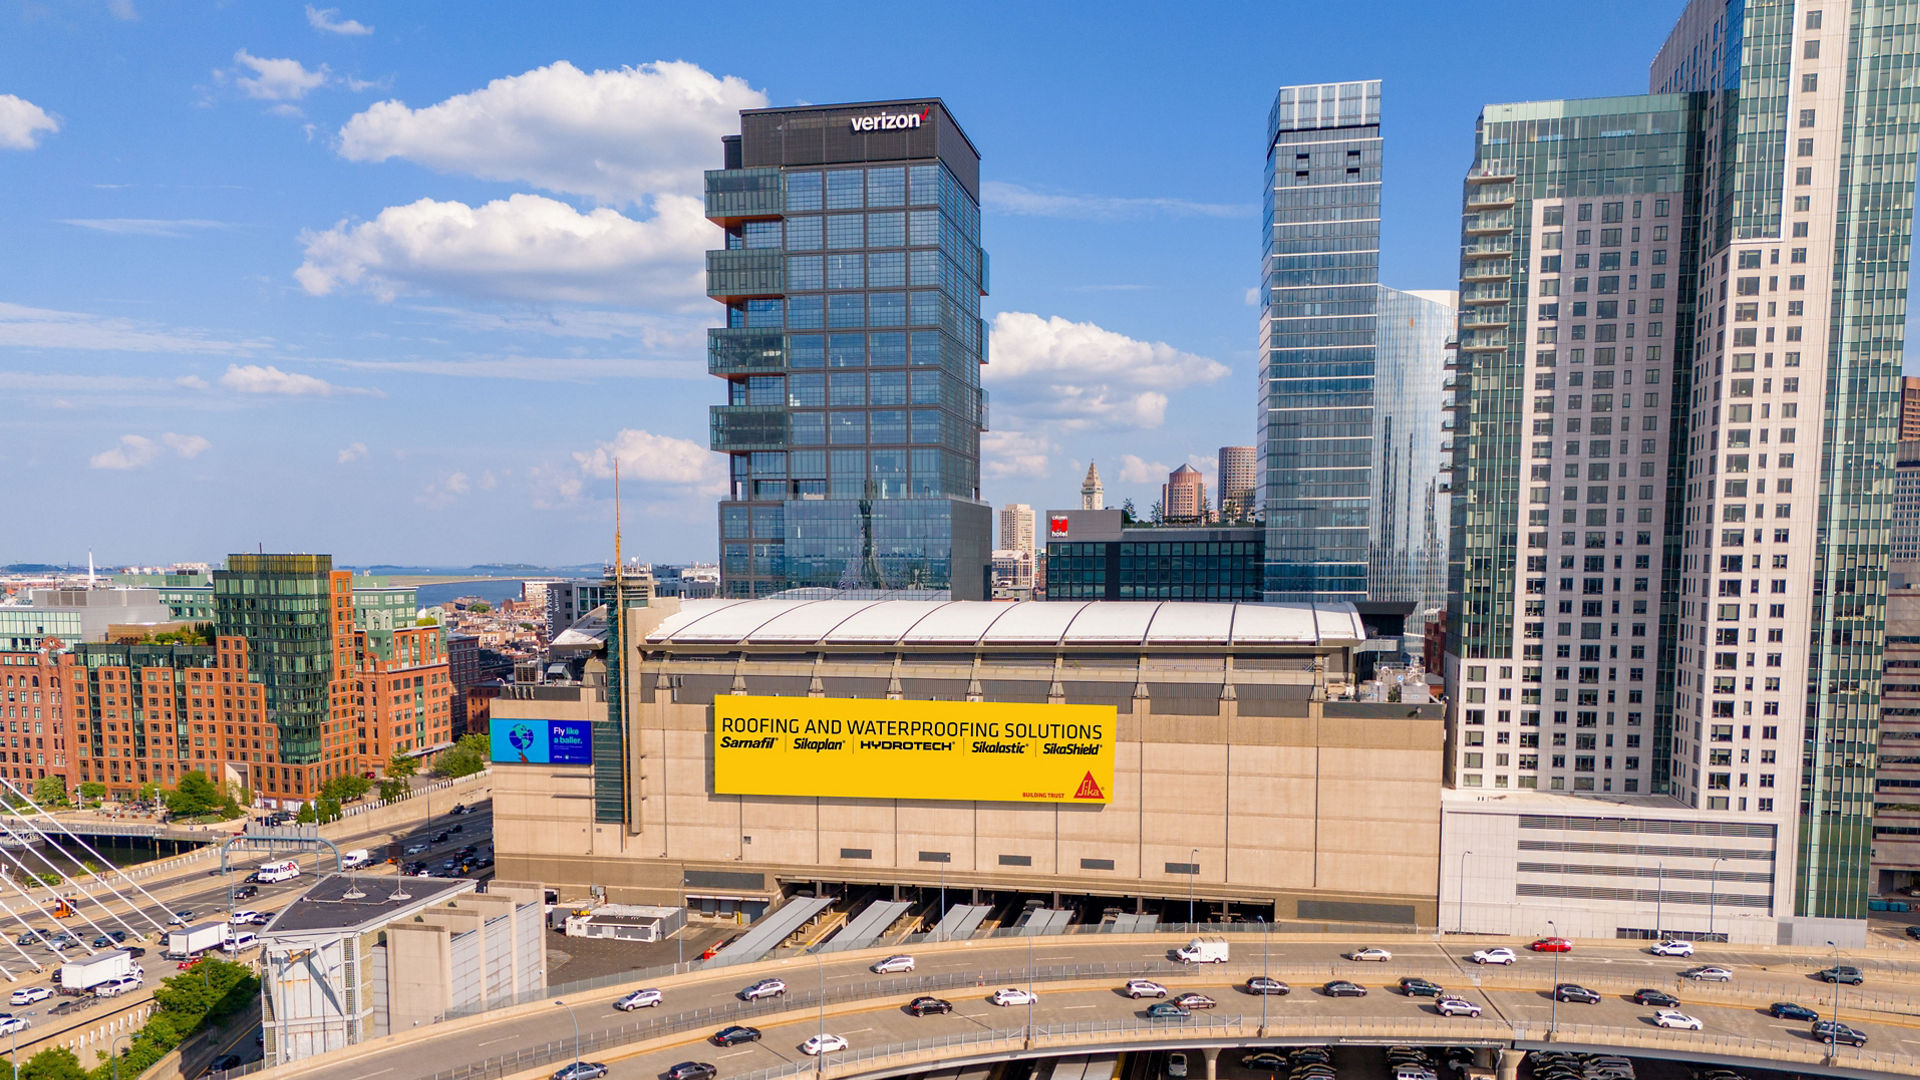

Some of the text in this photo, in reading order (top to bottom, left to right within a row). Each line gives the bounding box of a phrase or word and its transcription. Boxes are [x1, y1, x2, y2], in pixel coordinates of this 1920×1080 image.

[851, 111, 920, 131] verizon
[553, 726, 565, 736] Fly
[722, 717, 1103, 740] ROOFING AND WATERPROOFING SOLUTIONS
[1078, 780, 1100, 797] Sika
